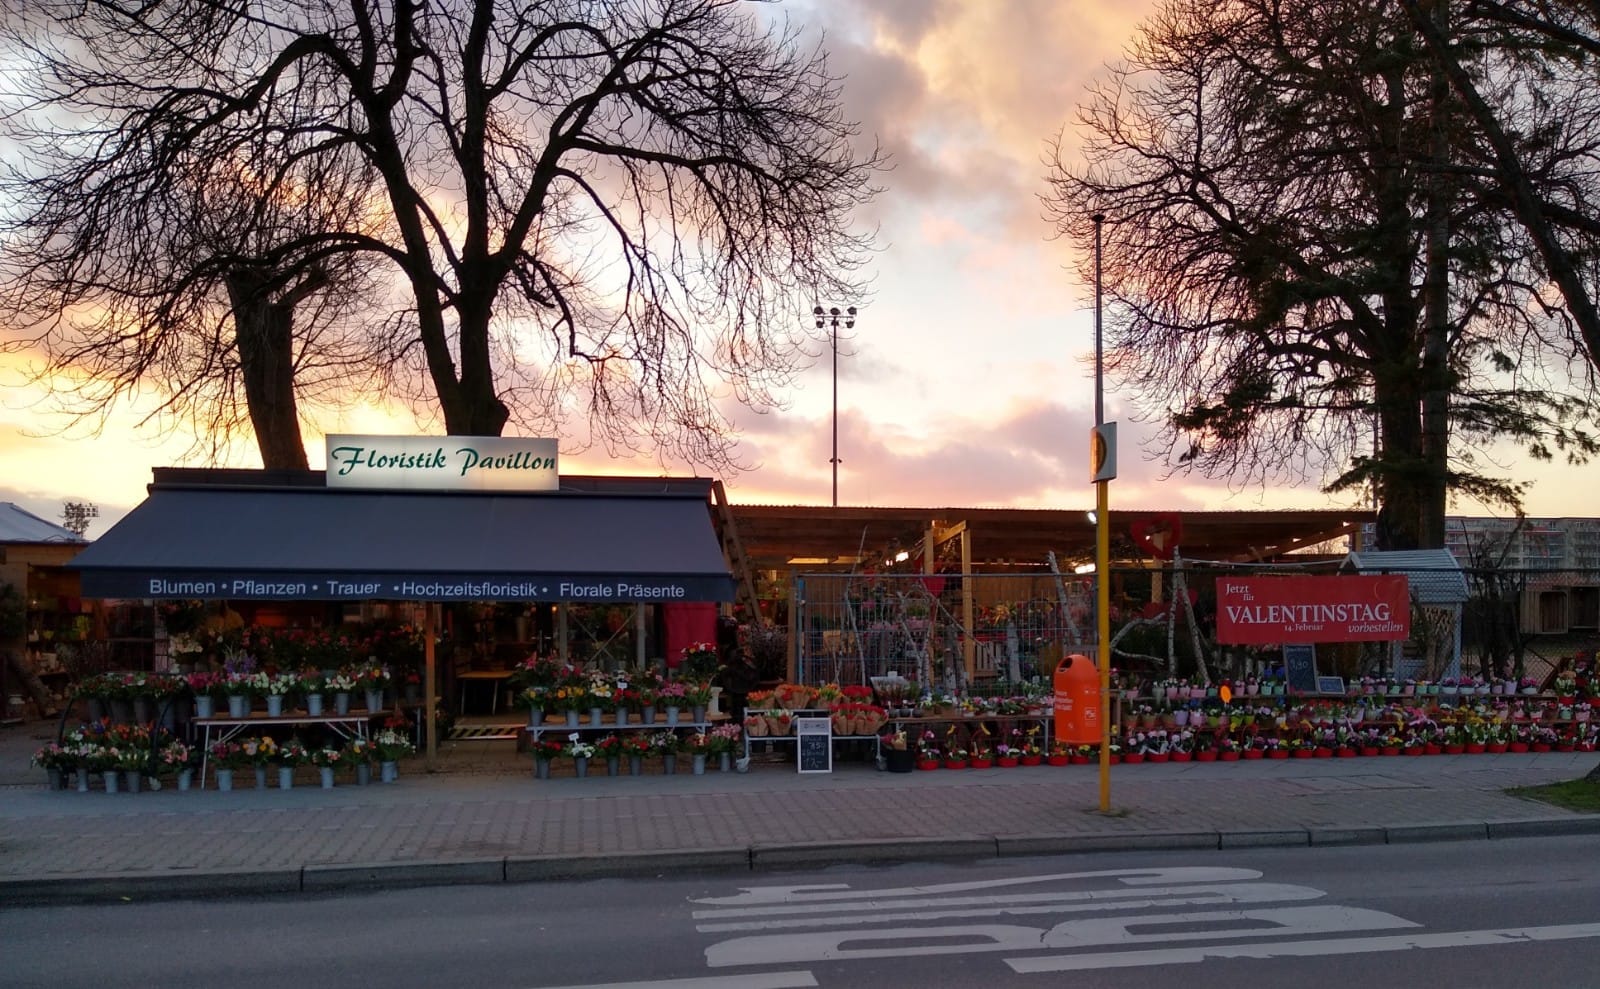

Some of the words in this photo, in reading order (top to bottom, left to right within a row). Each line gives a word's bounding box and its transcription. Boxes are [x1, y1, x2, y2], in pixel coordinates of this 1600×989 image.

[331, 446, 447, 476] Floristik
[455, 447, 555, 477] Pavillon
[150, 579, 216, 595] Blumen
[232, 580, 307, 596] Pflanzen
[326, 580, 381, 596] Trauer
[402, 581, 537, 597] Hochzeitsfloristik
[559, 582, 613, 598] Florale
[617, 582, 685, 598] Präsente
[1225, 583, 1249, 595] Jetzt
[1243, 593, 1255, 601] für
[1225, 603, 1391, 624] VALENTINSTAG
[1284, 624, 1294, 632] 14.
[1294, 623, 1324, 632] Februar
[1348, 621, 1404, 633] vorbestellen
